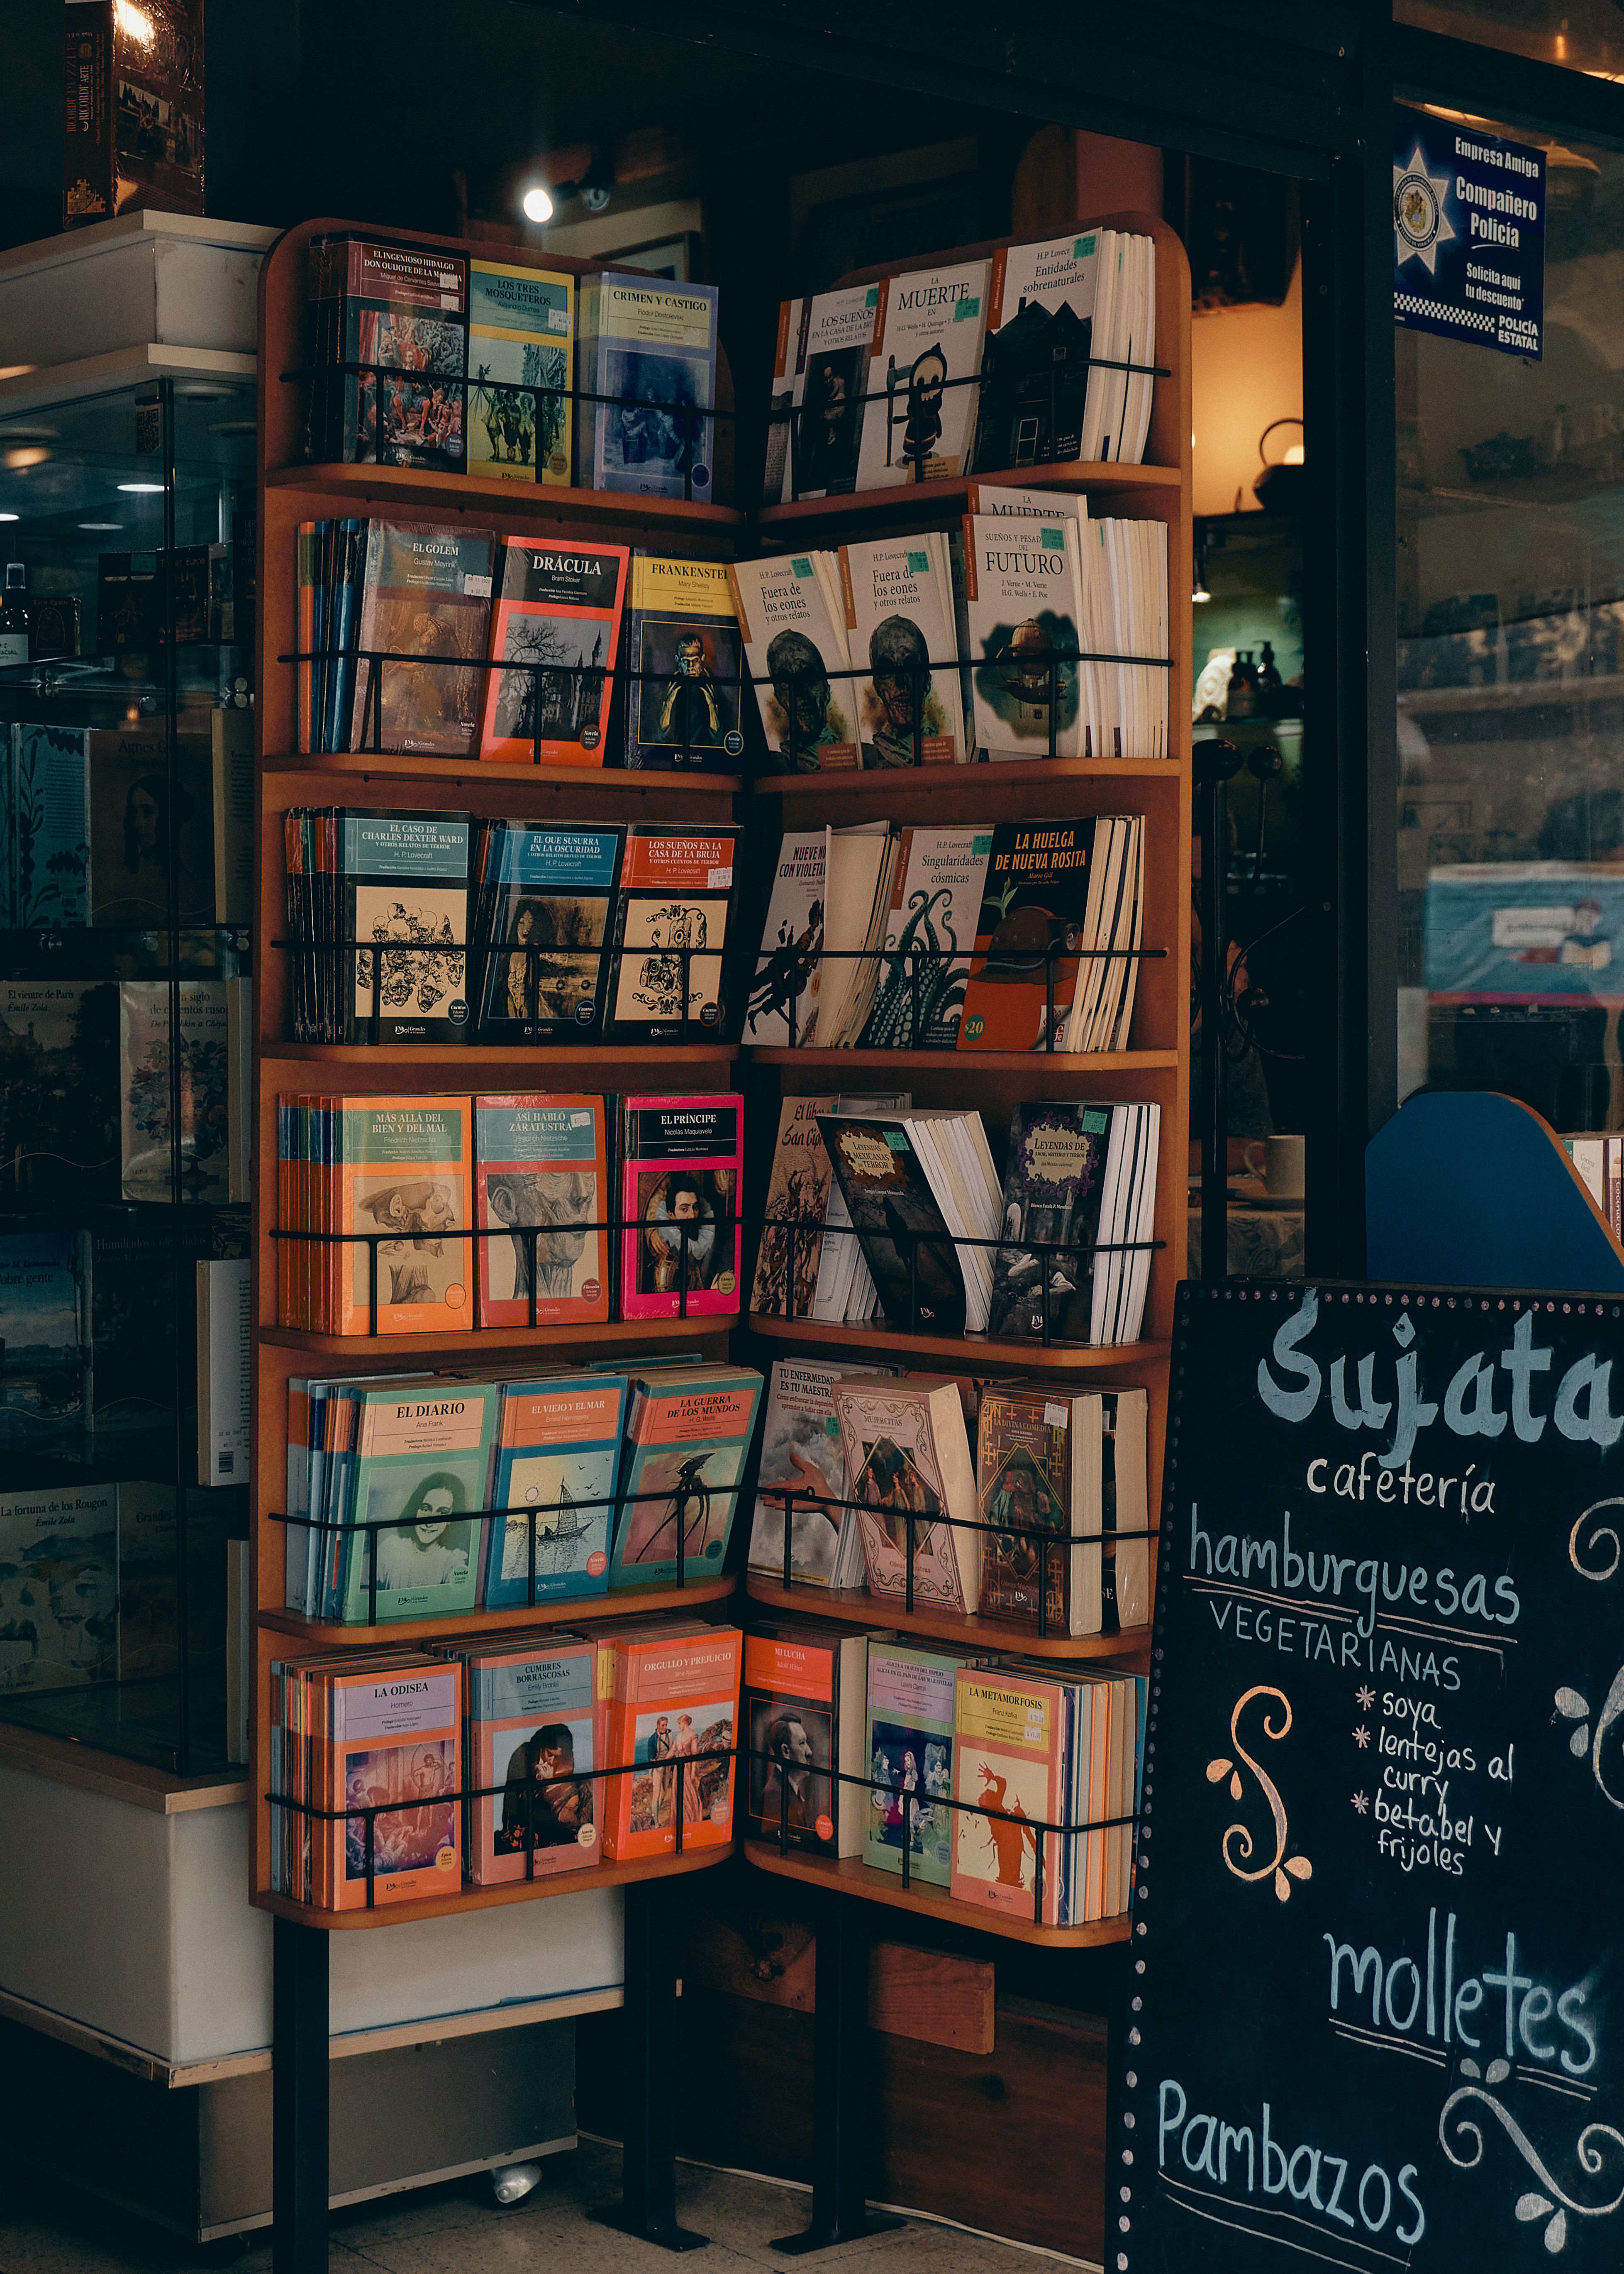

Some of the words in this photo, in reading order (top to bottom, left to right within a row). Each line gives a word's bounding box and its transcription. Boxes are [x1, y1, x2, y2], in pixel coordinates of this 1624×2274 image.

[80, 65, 89, 83] ARTE
[1455, 136, 1503, 167] Empresa
[1505, 152, 1540, 178] Amiga
[1456, 176, 1537, 221] Compañero
[1470, 212, 1520, 248] Policía
[364, 259, 381, 269] DON
[381, 261, 412, 273] QUIJOTE
[383, 252, 422, 265] INGENIOSO
[423, 258, 454, 271] HIDALGO
[1035, 259, 1077, 277] Entidades
[380, 272, 397, 282] Miguel
[404, 275, 426, 285] Cervantes
[1022, 273, 1085, 293] sobrenaturales
[1466, 262, 1500, 286] Solicita
[1501, 274, 1521, 291] aquí
[497, 280, 515, 291] LOS
[516, 283, 539, 294] TRES
[1466, 283, 1475, 298] tu
[485, 288, 551, 306] MOSQUETEROS
[613, 291, 653, 304] CRIMEN
[665, 297, 707, 311] CASTIGO
[897, 283, 970, 310] MUERTE
[821, 316, 838, 328] LOS
[839, 308, 874, 324] SUEÑOS
[1499, 315, 1539, 337] POLICÍA
[1498, 330, 1539, 352] ESTATAL
[985, 532, 1013, 542] SUEÑOS
[412, 542, 425, 553] EL
[425, 543, 459, 557] GOLEM
[532, 553, 602, 575] DRÁCULA
[985, 551, 1063, 575] FUTURO
[652, 564, 727, 579] FRANKENSTEI
[873, 569, 900, 583] Fuera
[678, 580, 691, 590] Mary
[692, 581, 710, 591] Shelley
[761, 587, 788, 599] Fuera
[790, 582, 801, 596] de
[873, 584, 888, 597] los
[890, 583, 918, 595] eones
[763, 600, 778, 613] los
[780, 598, 807, 611] eones
[879, 598, 897, 607] otros
[898, 595, 920, 605] relatos
[771, 614, 788, 623] otros
[789, 610, 810, 620] relatos
[119, 739, 154, 758] Agnes
[402, 824, 424, 833] CASO
[361, 831, 401, 841] CHARLES
[403, 833, 437, 843] DEXTER
[439, 835, 463, 844] WARD
[561, 836, 599, 846] SUSURRA
[1015, 833, 1030, 850] LA
[1032, 830, 1075, 848] HUELGA
[554, 845, 600, 855] OSCURIDAD
[648, 849, 669, 858] CASA
[696, 850, 720, 859] BRUJA
[792, 846, 818, 861] NUEVE
[922, 855, 984, 869] Singularidades
[995, 854, 1010, 871] DE
[1012, 852, 1048, 870] NUEVA
[1051, 850, 1086, 868] ROSITA
[779, 863, 796, 877] CON
[1044, 872, 1053, 880] Gill
[931, 872, 969, 884] cósmicas
[8, 989, 16, 999] El
[17, 990, 43, 999] vientre
[45, 990, 55, 999] de
[56, 989, 74, 999] París
[189, 992, 210, 1003] siglo
[7, 1002, 29, 1012] Émile
[31, 1003, 48, 1012] Zola
[964, 1021, 984, 1034] $20
[425, 1113, 443, 1122] DEL
[661, 1115, 673, 1125] EL
[673, 1113, 717, 1124] PRÍNCIPE
[373, 1124, 395, 1133] BIEN
[407, 1124, 425, 1133] DEL
[426, 1124, 446, 1133] MAL
[509, 1122, 573, 1132] ZARATUSTRA
[684, 1128, 713, 1136] Maquiavelo
[782, 1123, 805, 1146] San
[1034, 1138, 1073, 1150] LEYENDAS
[1074, 1142, 1085, 1150] DE
[853, 1152, 890, 1161] MEXICANAS
[26, 1273, 54, 1286] gente
[780, 1368, 789, 1378] TU
[1258, 1287, 1624, 1469] Sujata
[780, 1381, 789, 1390] ES
[790, 1382, 800, 1392] TU
[680, 1399, 691, 1407] LA
[694, 1395, 731, 1406] GUERRA
[777, 1393, 788, 1402] Cómo
[789, 1395, 810, 1404] enfrentar
[814, 1399, 834, 1409] depresión
[781, 1403, 800, 1412] aprender
[396, 1406, 413, 1419] EL
[415, 1402, 465, 1418] DIARIO
[681, 1407, 698, 1417] LOS
[700, 1403, 740, 1415] MUNDOS
[1307, 1452, 1495, 1514] cafetería
[0, 1506, 12, 1517] La
[14, 1504, 46, 1516] fortuna
[48, 1502, 59, 1512] de
[61, 1500, 74, 1512] los
[34, 1517, 57, 1528] Émile
[58, 1515, 75, 1525] Zola
[453, 1568, 468, 1576] Novela
[1190, 1502, 1520, 1638] hamburguesas
[1210, 1600, 1461, 1690] VEGETARIANAS
[644, 1659, 683, 1672] ORGULLO
[690, 1652, 732, 1666] PREJUICIO
[783, 1649, 806, 1661] LUCHA
[516, 1668, 571, 1683] BORRASCOSAS
[374, 1688, 389, 1699] LA
[390, 1682, 429, 1696] ODISEA
[390, 1700, 414, 1710] Homero
[969, 1687, 979, 1697] LA
[980, 1689, 1042, 1710] METAMORFOSIS
[992, 1708, 1005, 1716] Franz
[1005, 1710, 1018, 1720] Kafka
[1379, 1726, 1476, 1776] lentejas
[1488, 1743, 1514, 1781] al
[1383, 1766, 1449, 1817] curry
[1375, 1788, 1473, 1847] betabel
[1485, 1824, 1502, 1856] y
[1378, 1829, 1465, 1876] frijoles
[1322, 1907, 1596, 2074] molletes
[1159, 2079, 1425, 2246] Pambazos
